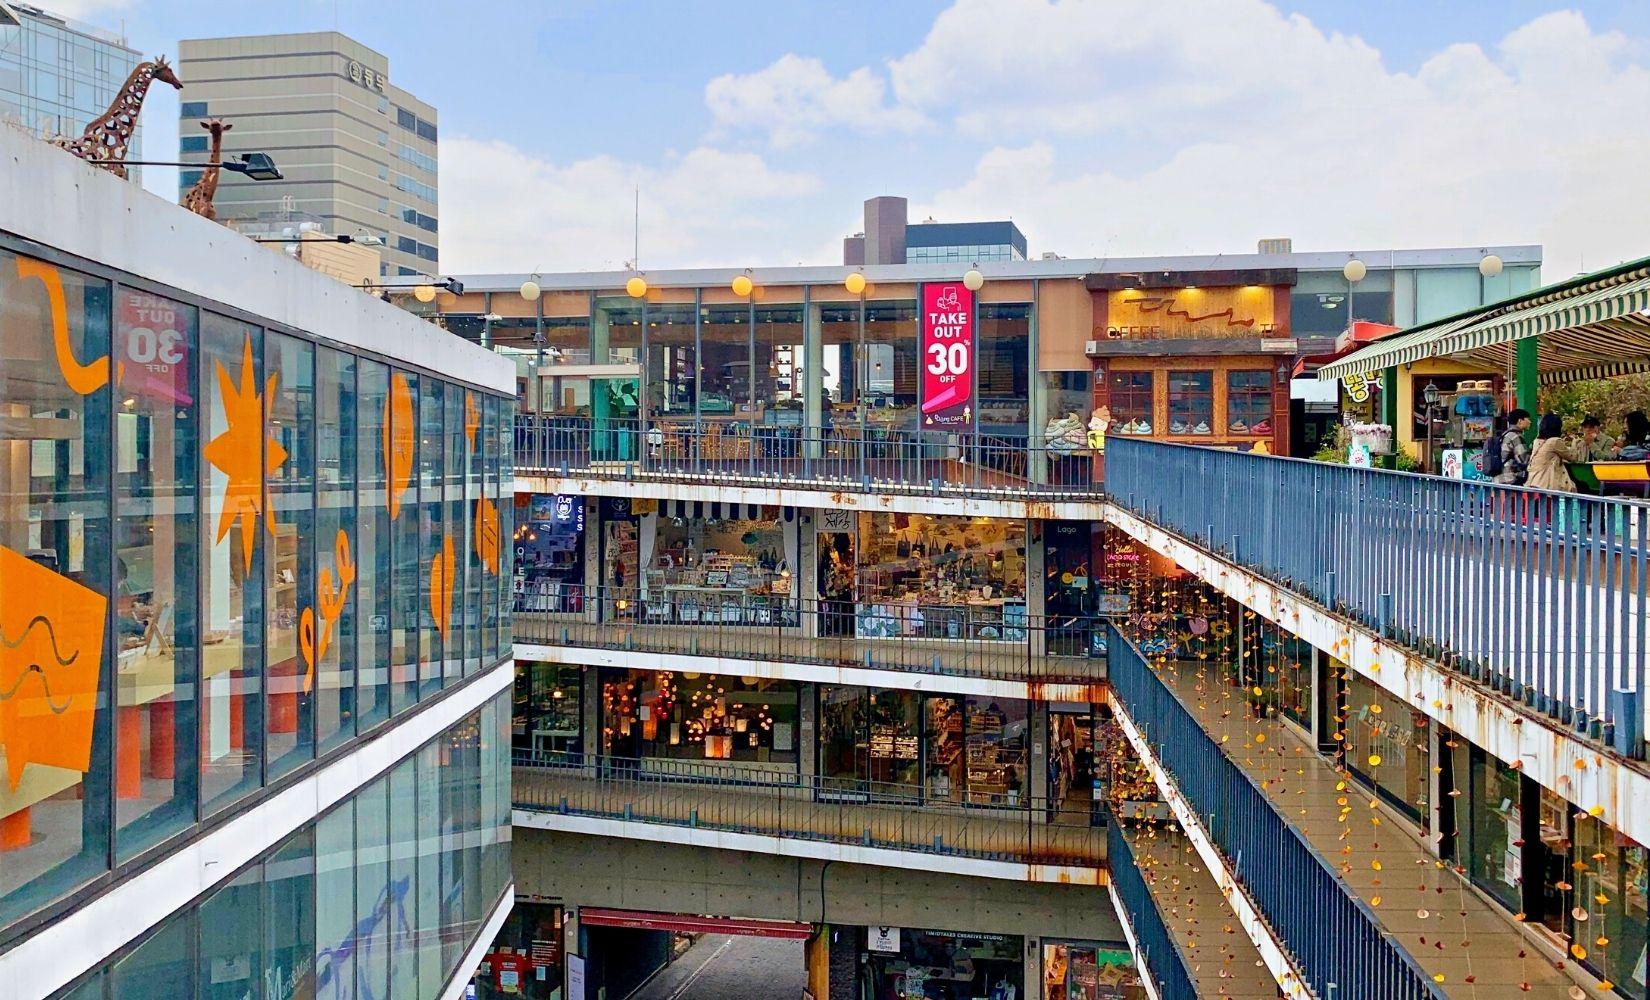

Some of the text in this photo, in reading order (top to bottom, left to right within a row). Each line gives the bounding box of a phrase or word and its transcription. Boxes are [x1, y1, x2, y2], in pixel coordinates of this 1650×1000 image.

[929, 313, 967, 325] TAKE
[934, 326, 962, 338] OUT
[1092, 325, 1160, 340] COFFEE
[940, 375, 956, 383] OFF
[1057, 526, 1077, 535] Lago
